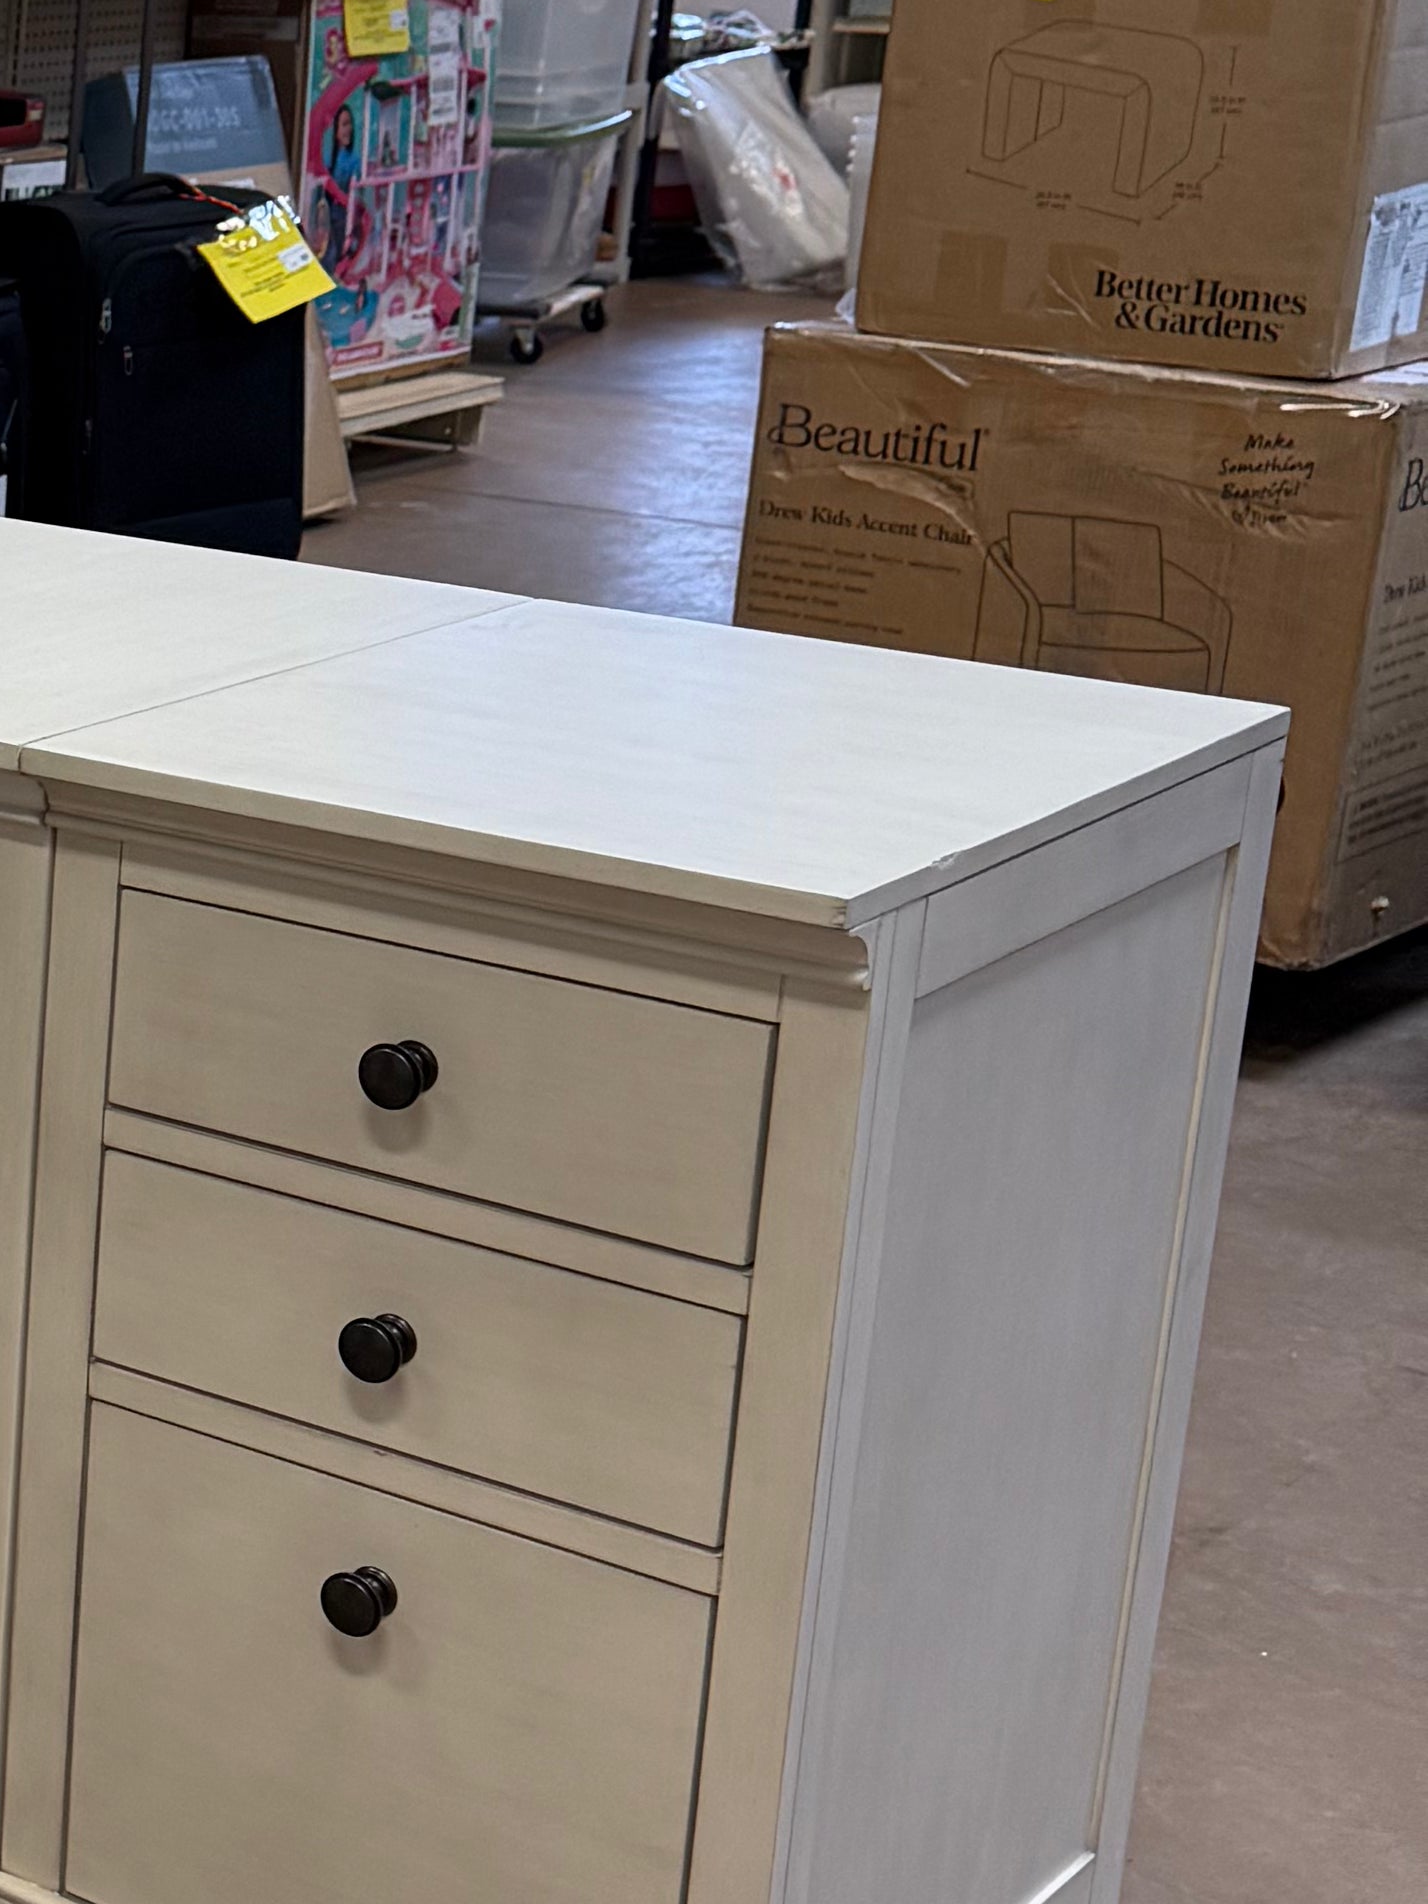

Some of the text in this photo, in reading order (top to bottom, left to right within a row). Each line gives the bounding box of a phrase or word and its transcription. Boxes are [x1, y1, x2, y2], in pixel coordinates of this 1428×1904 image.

[1094, 269, 1308, 316] Better Homes
[766, 402, 983, 472] Beautiful
[1243, 431, 1295, 452] Make
[1218, 454, 1315, 480] Something
[1221, 480, 1301, 504] Beautiful
[810, 505, 852, 528] Kids
[855, 513, 918, 538] Accent
[922, 523, 973, 546] Chair
